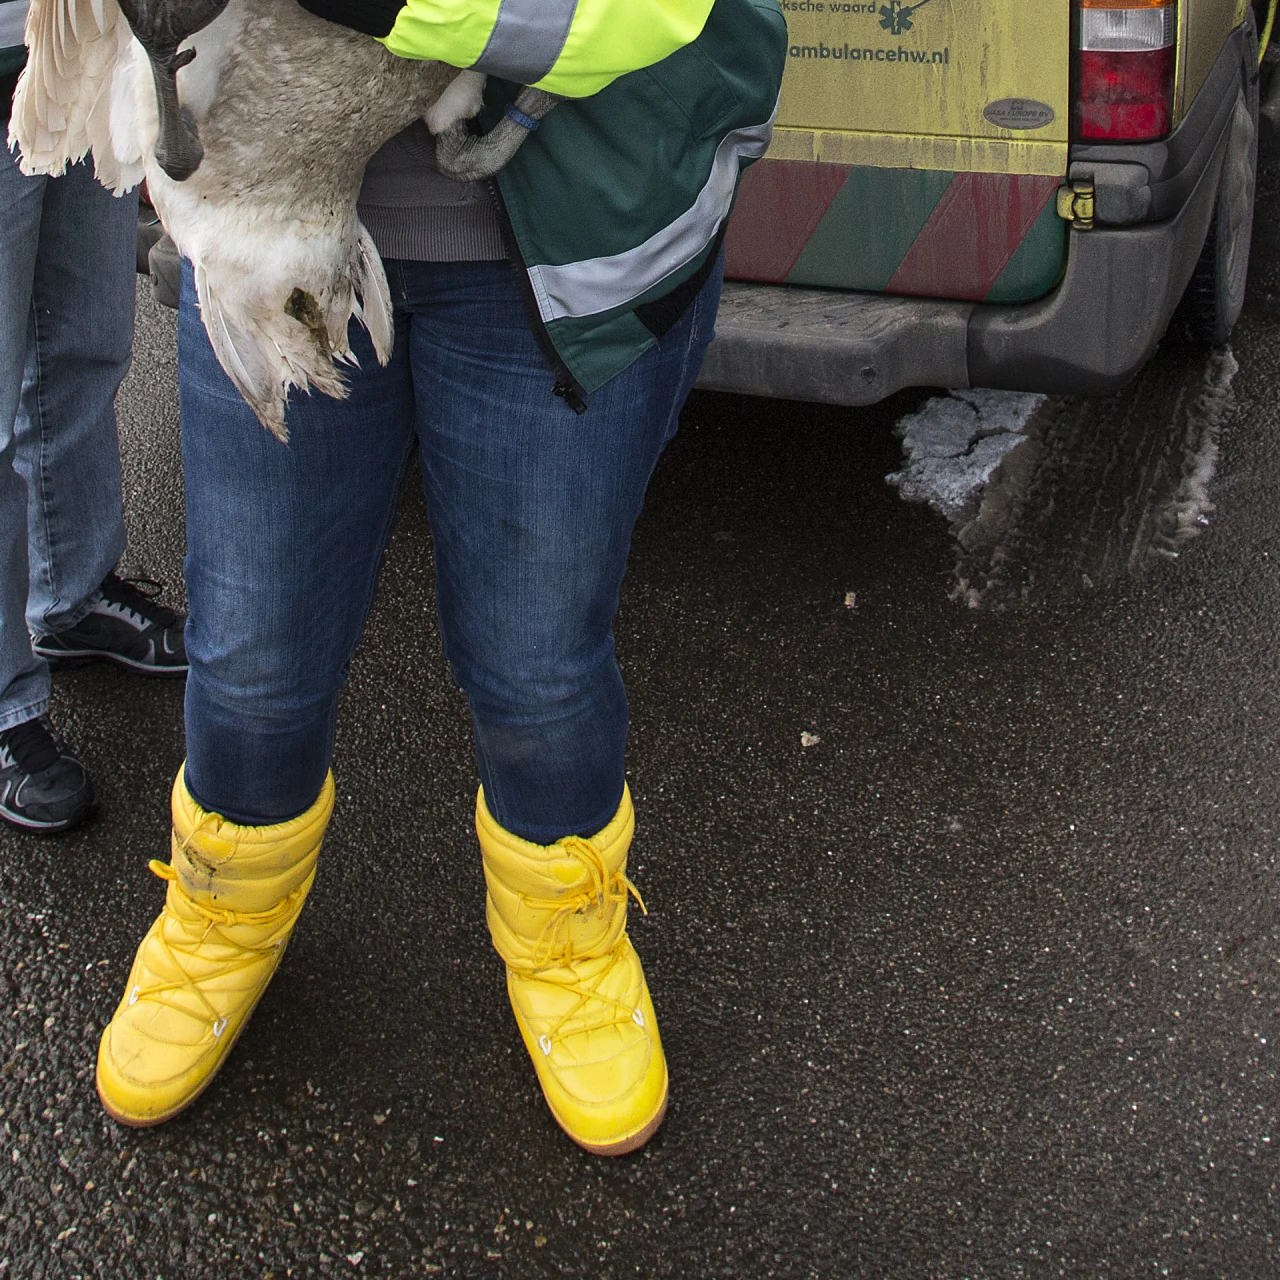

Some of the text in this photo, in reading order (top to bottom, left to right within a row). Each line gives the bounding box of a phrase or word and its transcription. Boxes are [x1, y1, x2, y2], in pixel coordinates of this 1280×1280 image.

[780, 0, 876, 14] ksche waard
[789, 42, 949, 65] ambulancehw.nl
